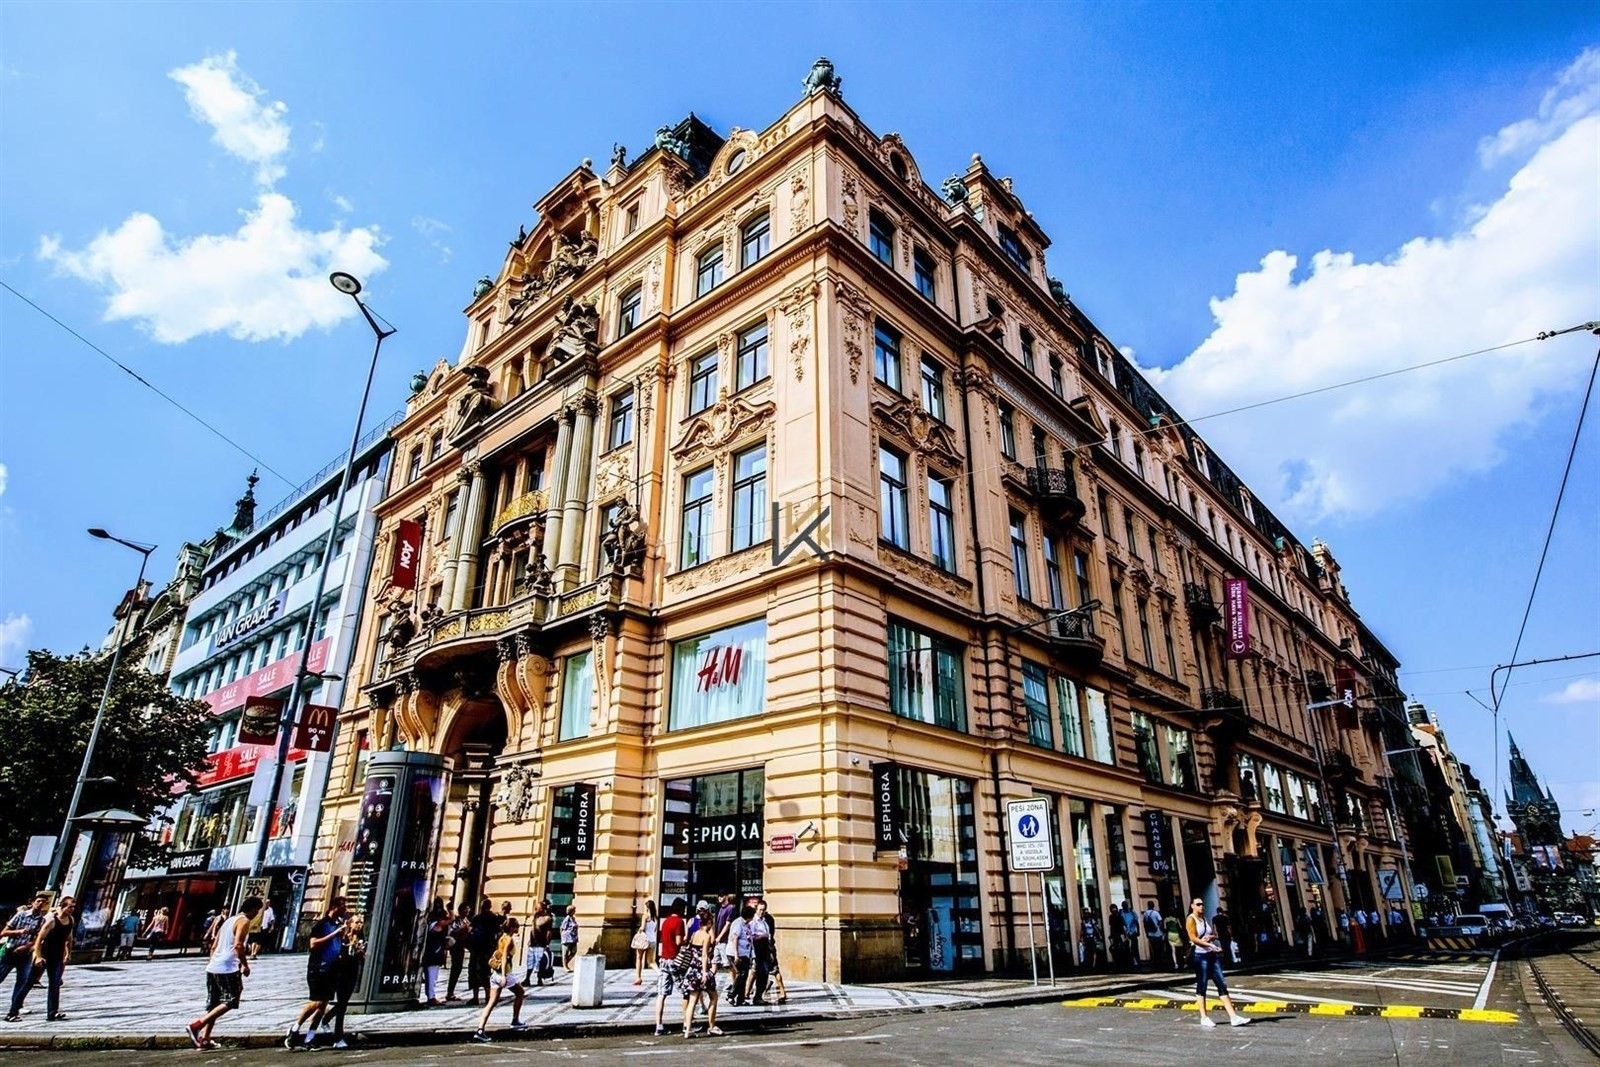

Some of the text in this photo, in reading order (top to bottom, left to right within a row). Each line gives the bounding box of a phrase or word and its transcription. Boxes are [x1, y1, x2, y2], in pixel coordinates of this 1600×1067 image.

[400, 540, 415, 569] AON
[215, 599, 278, 646] VAN GRAAF
[308, 646, 323, 660] ALE
[258, 668, 277, 682] SALE
[697, 646, 743, 692] H&M
[222, 685, 239, 701] SALE
[240, 747, 259, 762] SALE
[881, 772, 892, 841] SEPHORA
[576, 792, 589, 852] SEPHORA
[682, 822, 760, 844] SEPHORA
[1150, 813, 1161, 857] CHANGE
[170, 854, 205, 869] VAN GRAAF
[1153, 860, 1169, 870] 0%
[245, 886, 265, 896] 70%
